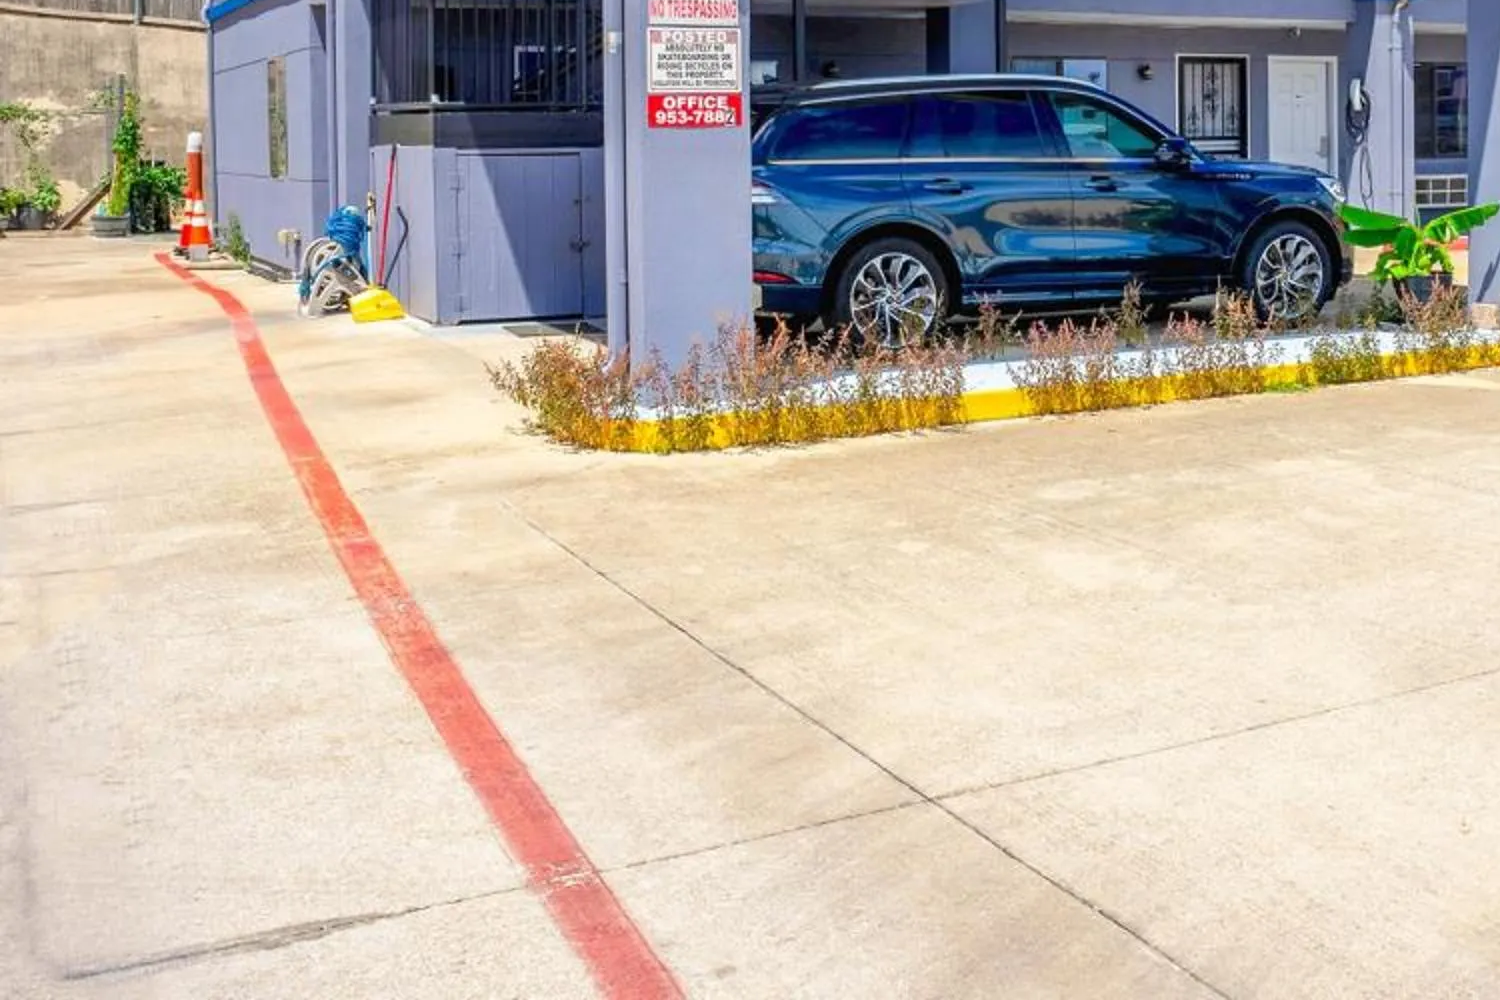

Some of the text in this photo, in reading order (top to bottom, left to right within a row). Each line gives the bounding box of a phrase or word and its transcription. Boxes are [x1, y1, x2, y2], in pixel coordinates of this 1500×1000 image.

[650, 0, 737, 18] NO TRESPASSING
[661, 31, 727, 43] POSTED
[663, 96, 728, 109] OFFICE
